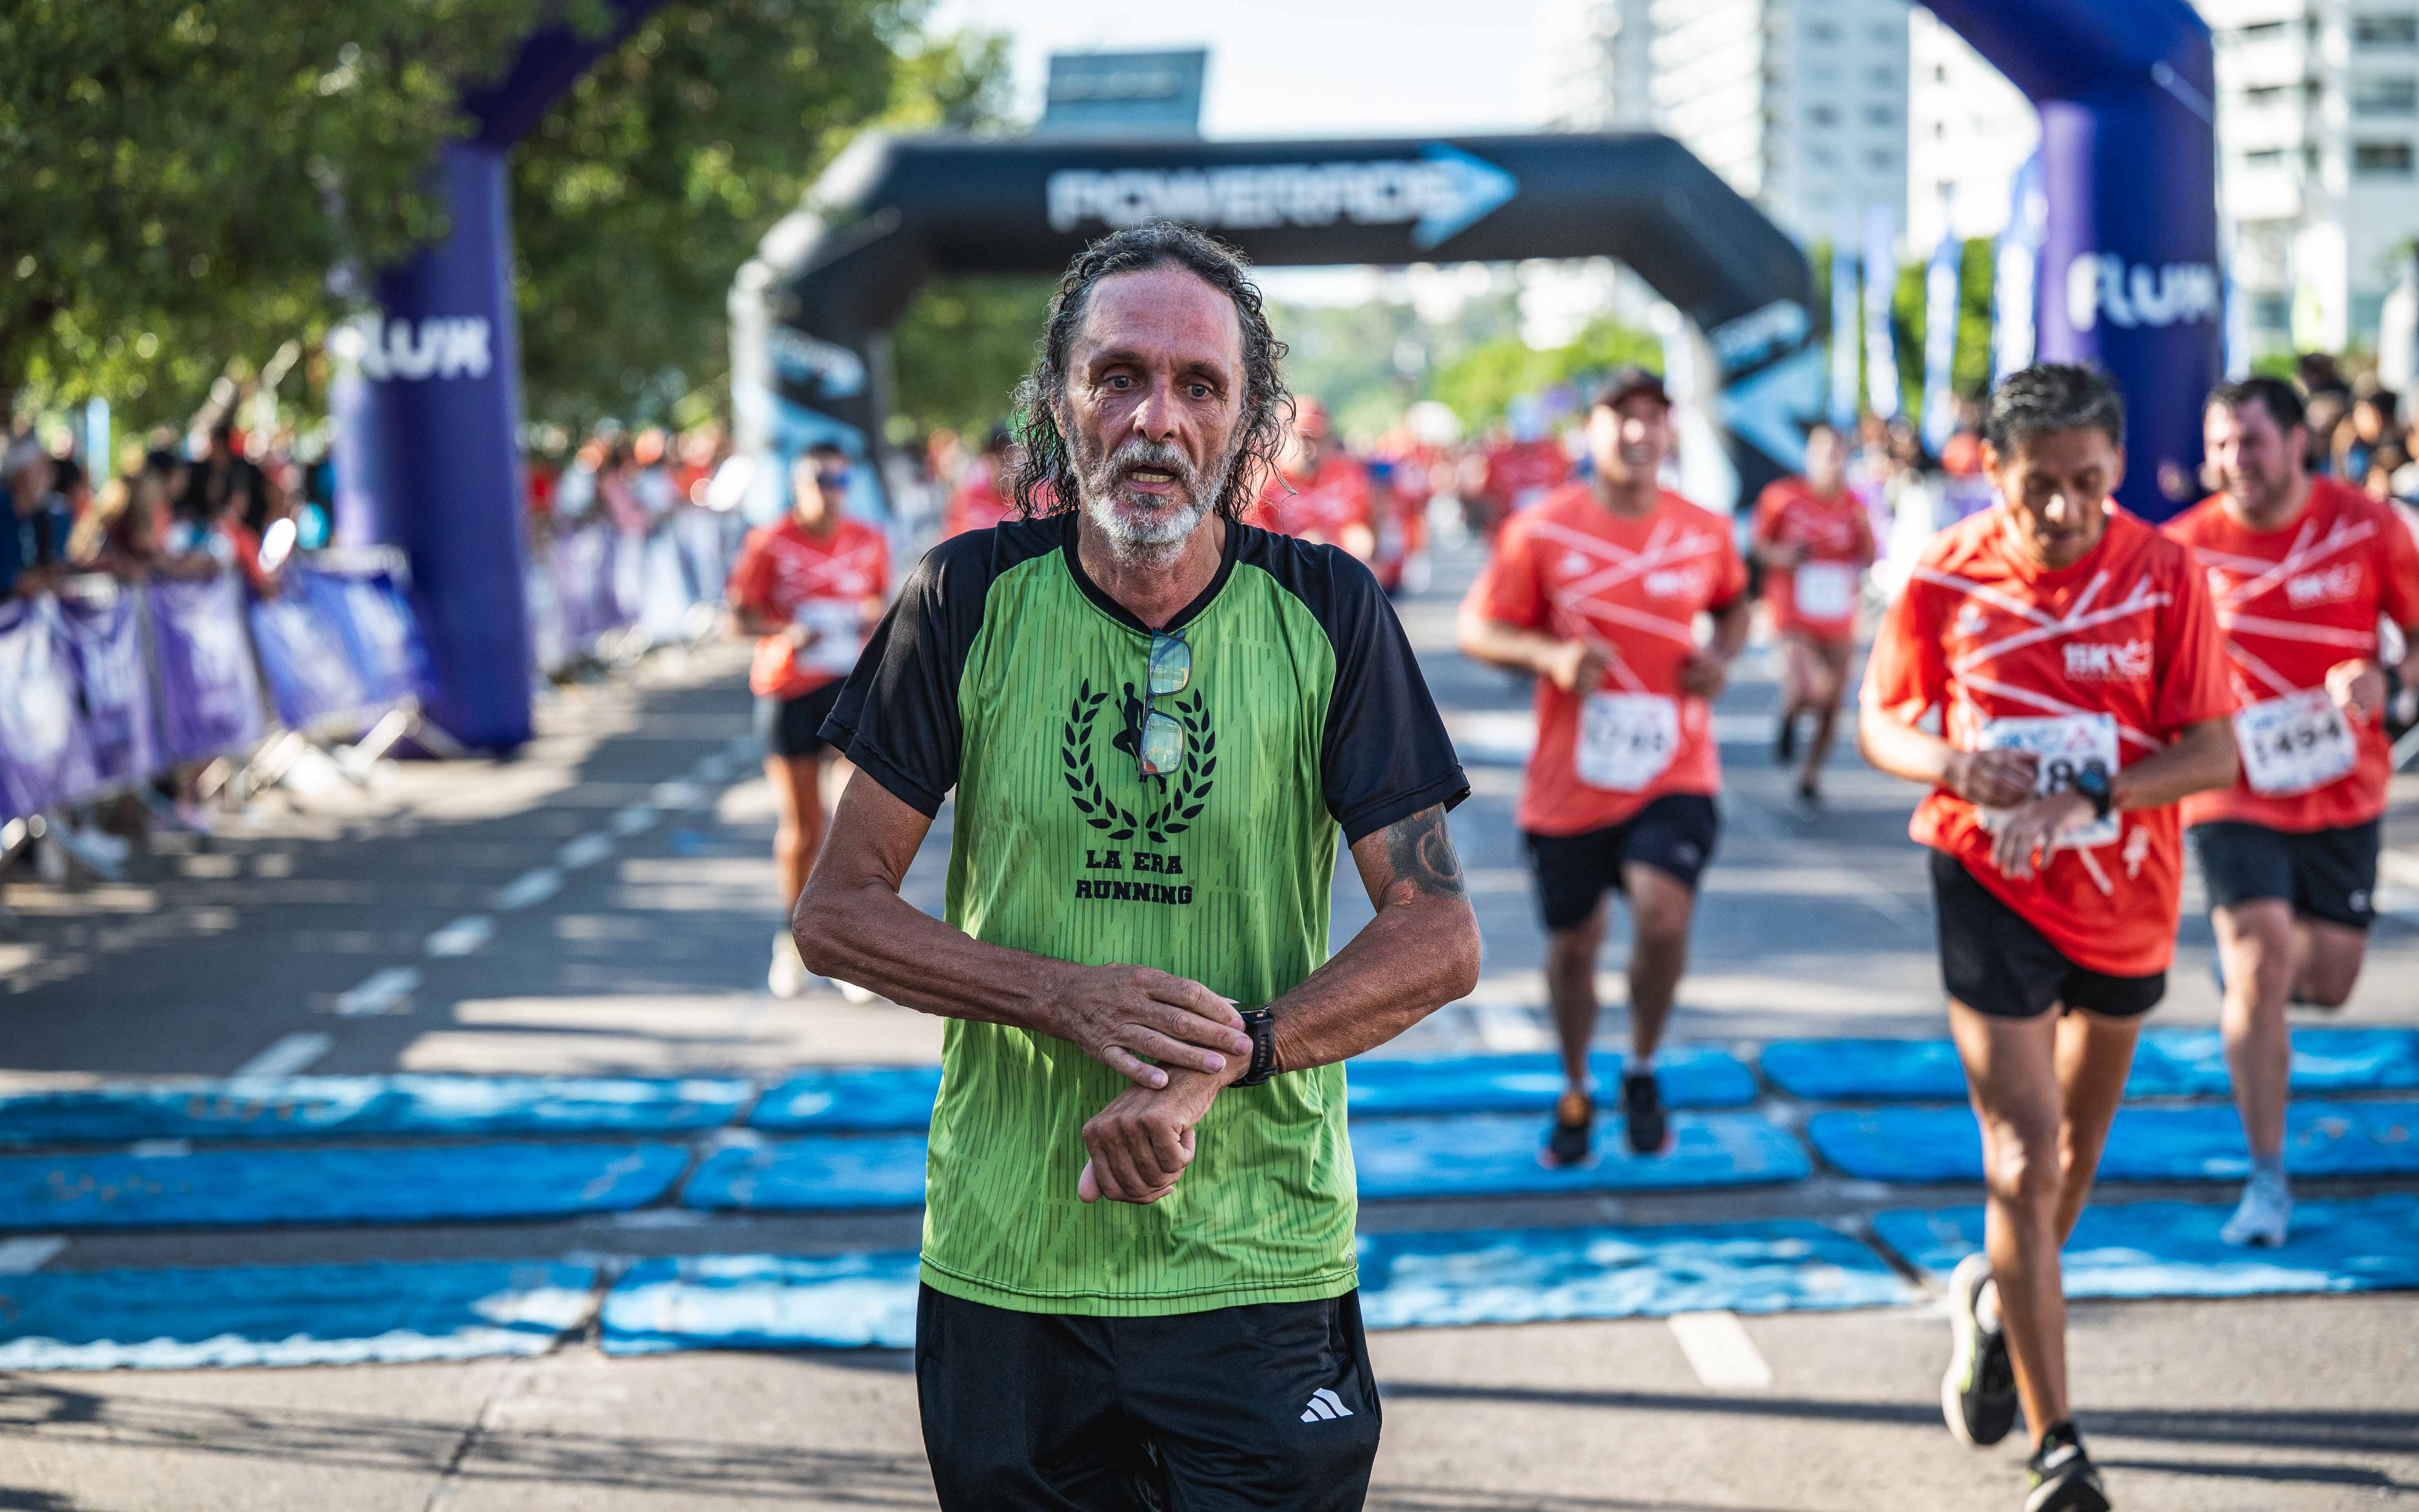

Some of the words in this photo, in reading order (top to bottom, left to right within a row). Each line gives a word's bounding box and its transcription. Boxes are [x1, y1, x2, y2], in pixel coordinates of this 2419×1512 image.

[1086, 850, 1122, 869] LA
[1133, 851, 1183, 874] ERA
[1075, 879, 1193, 905] RUNNING
